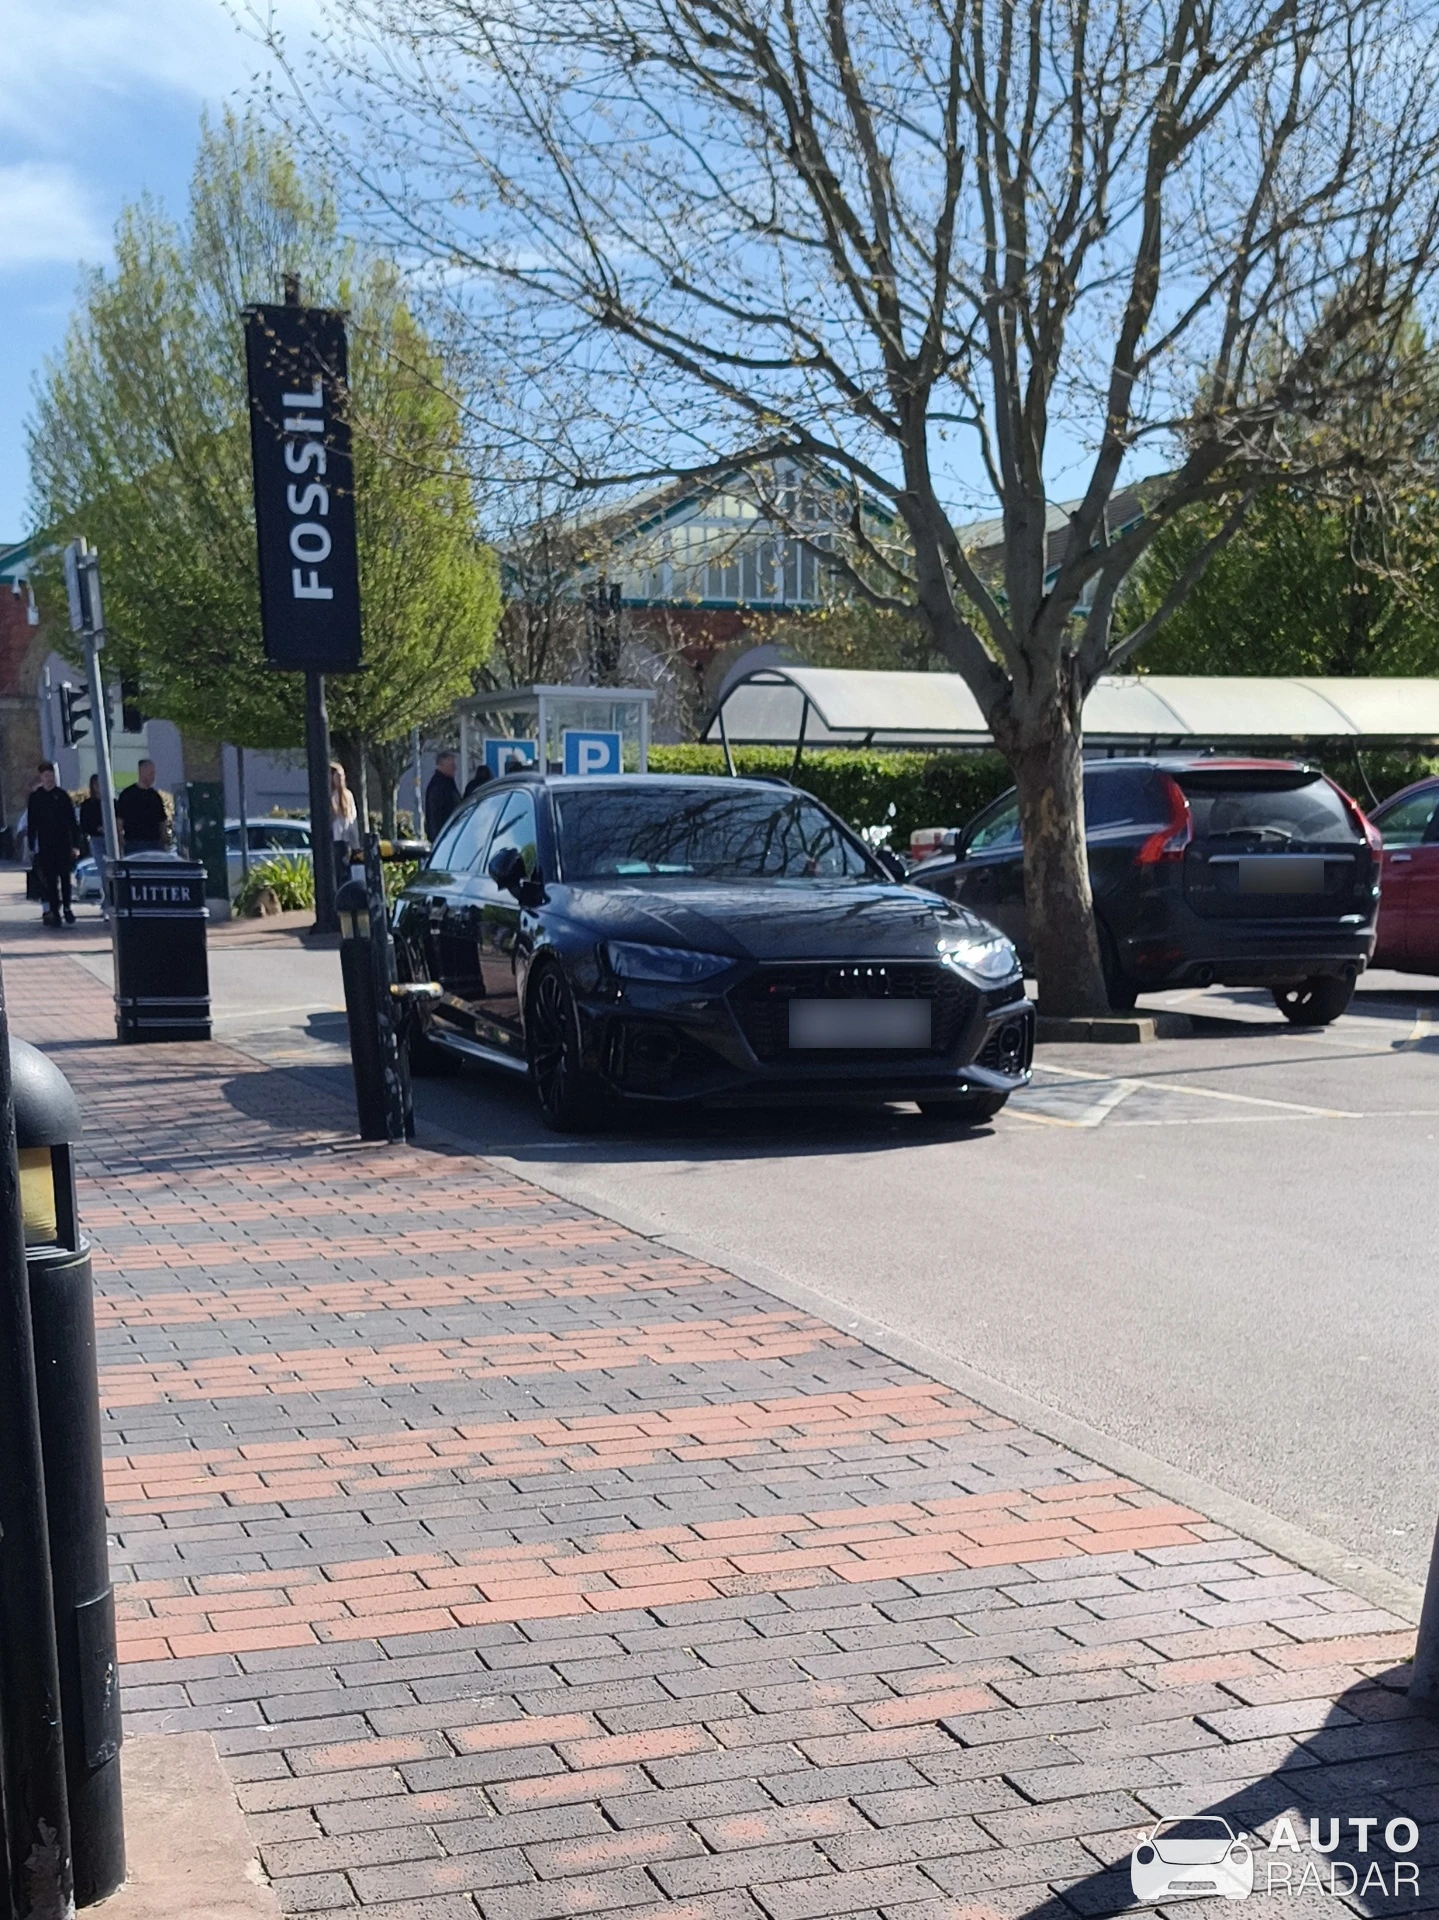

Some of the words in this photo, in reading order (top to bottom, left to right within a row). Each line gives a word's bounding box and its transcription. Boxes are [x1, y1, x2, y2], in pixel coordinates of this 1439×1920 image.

[281, 374, 334, 599] FOSSIL
[578, 739, 610, 774] P
[130, 885, 191, 901] LITTER
